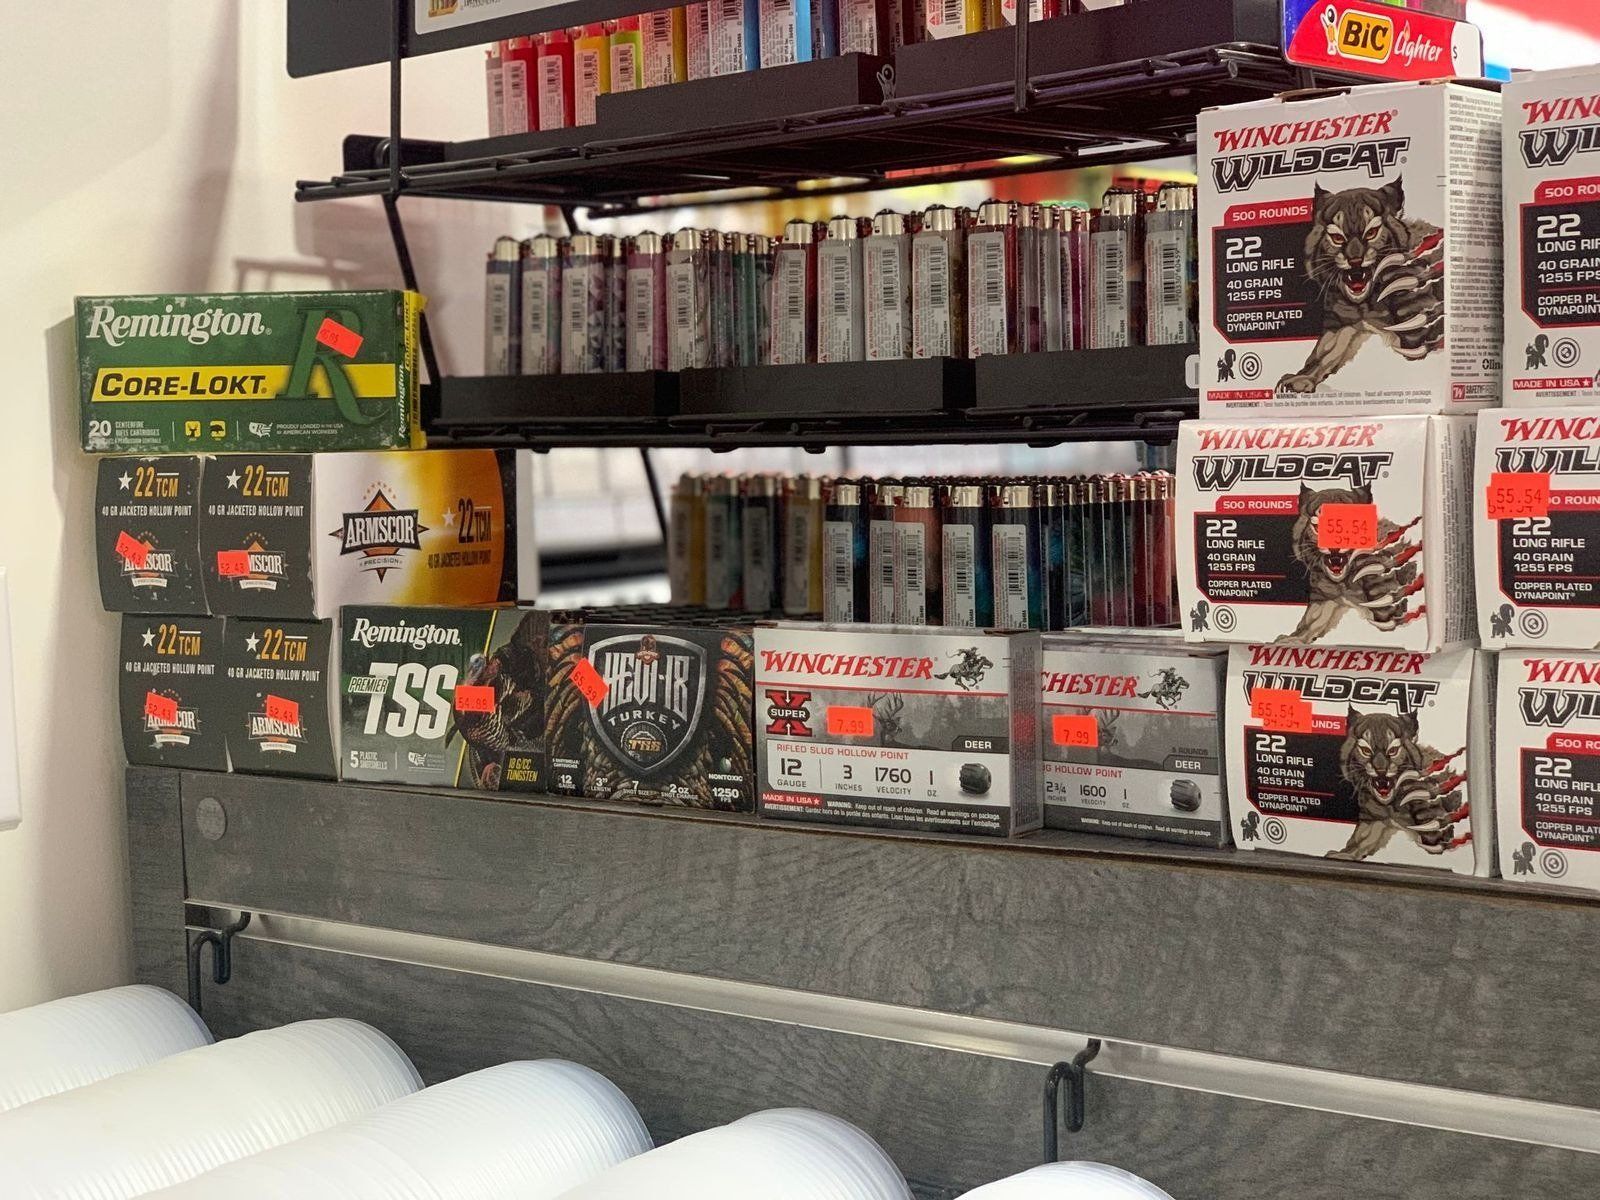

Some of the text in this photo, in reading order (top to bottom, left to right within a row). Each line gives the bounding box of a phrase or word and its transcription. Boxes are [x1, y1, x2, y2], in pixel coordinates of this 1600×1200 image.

[1394, 29, 1443, 67] Lighter
[1213, 110, 1392, 152] WINCHESTER
[1211, 137, 1410, 193] WILDCAT
[1545, 187, 1573, 198] 500
[1232, 206, 1308, 221] 500 ROUNDS
[1537, 214, 1581, 238] 22
[1226, 236, 1262, 260] 22
[1537, 240, 1576, 253] LONG
[1226, 258, 1295, 273] LONG RIFLE
[1537, 258, 1600, 270] 40 GRAIN
[1226, 277, 1283, 289] 40 GRAIN
[1538, 272, 1573, 283] 1255
[1227, 289, 1282, 301] 1255 FPS
[1538, 295, 1582, 306] COPPER
[1226, 309, 1303, 323] COPPER PLATED
[86, 304, 266, 347] Remington
[1226, 321, 1281, 333] DYNAPOINT
[1514, 379, 1581, 389] MADE IN USA
[89, 420, 112, 437] 20
[1197, 424, 1377, 451] WINCHESTER
[1192, 452, 1394, 491] WILDCAT
[133, 466, 156, 497] 22
[242, 464, 265, 497] 22
[265, 476, 289, 497] TCM
[156, 477, 179, 498] TCM
[1496, 488, 1542, 504] 55.54
[102, 505, 192, 517] 40 GR JACKETED HOLLOW POINT
[208, 505, 304, 517] 40 GR JACKETED HOLLOW POINT
[1223, 500, 1293, 509] 500 ROUNDS
[457, 498, 475, 543] 22
[474, 510, 492, 542] TCM
[1327, 519, 1368, 535] 55.54
[1512, 517, 1551, 536] 22
[345, 515, 416, 549] ARMSCOR
[1206, 519, 1238, 537] 22
[1206, 540, 1265, 549] LONG RIFLE
[1512, 538, 1585, 548] LONG RIFLE
[1207, 553, 1256, 562] 40 GRAIN
[1513, 552, 1574, 562] 40 GRAIN
[1208, 563, 1255, 572] 1255 FPS
[1514, 563, 1573, 573] 1255 FPS
[1208, 580, 1272, 589] COPPER PLATED
[1514, 582, 1593, 591] COPPER PLATED
[1208, 588, 1255, 598] DYNAPOINT
[1514, 591, 1570, 600] DYNAPOINT
[157, 624, 177, 655] 22
[350, 617, 461, 650] Remington
[178, 636, 202, 656] TCM
[261, 628, 283, 660] 22
[284, 641, 306, 662] TCM
[760, 649, 934, 680] WINCHESTER
[1248, 645, 1426, 675] WINCHESTER
[126, 662, 215, 675] 40 GR JACKETED HOLLOW POINT
[227, 667, 321, 682] 40 GR JACKETED HOLLOW POINT
[350, 678, 388, 693] PREMIER
[573, 671, 598, 701] 65.99
[363, 662, 459, 740] TSS
[771, 707, 807, 719] SUPER
[1257, 703, 1295, 718] 55.54
[607, 709, 681, 730] TURKEY
[836, 719, 865, 734] 7.99
[1063, 729, 1090, 745] 7.99
[1255, 734, 1287, 753] 22
[1555, 738, 1581, 748] 500
[964, 739, 992, 750] DEER
[776, 743, 909, 761] RIFLED SLUG HOLLOW POINT
[350, 751, 359, 768] 5
[1175, 759, 1201, 770] DEER
[1255, 753, 1314, 766] LONG RIFLE
[780, 758, 912, 784] 12 3 1760
[1054, 765, 1092, 776] HOLLOW
[1095, 768, 1123, 779] POINT
[1256, 767, 1305, 778] 40 GRAIN
[1534, 756, 1572, 777] 22
[506, 769, 539, 782] TUNGSTEN
[560, 774, 573, 784] 12
[708, 773, 743, 782] NONTOXIC
[1257, 776, 1304, 788] 1255 FPS
[631, 780, 639, 790] 7
[669, 783, 678, 793] 2
[777, 778, 938, 798] GAUGE INCHES VELOCITY OZ
[1535, 778, 1568, 789] LONG
[712, 786, 739, 798] 1250
[1079, 784, 1107, 797] 1600
[762, 793, 813, 805] MADE IN USA
[1080, 799, 1107, 807] VELOCITY
[1258, 792, 1321, 805] COPPER PLATED
[1535, 793, 1593, 805] 40 GRAIN
[1258, 801, 1304, 812] DYNAPOINT
[1536, 803, 1592, 815] 1255 FPS
[1535, 821, 1573, 831] COPPER
[1536, 830, 1590, 842] DYNAPOINT
